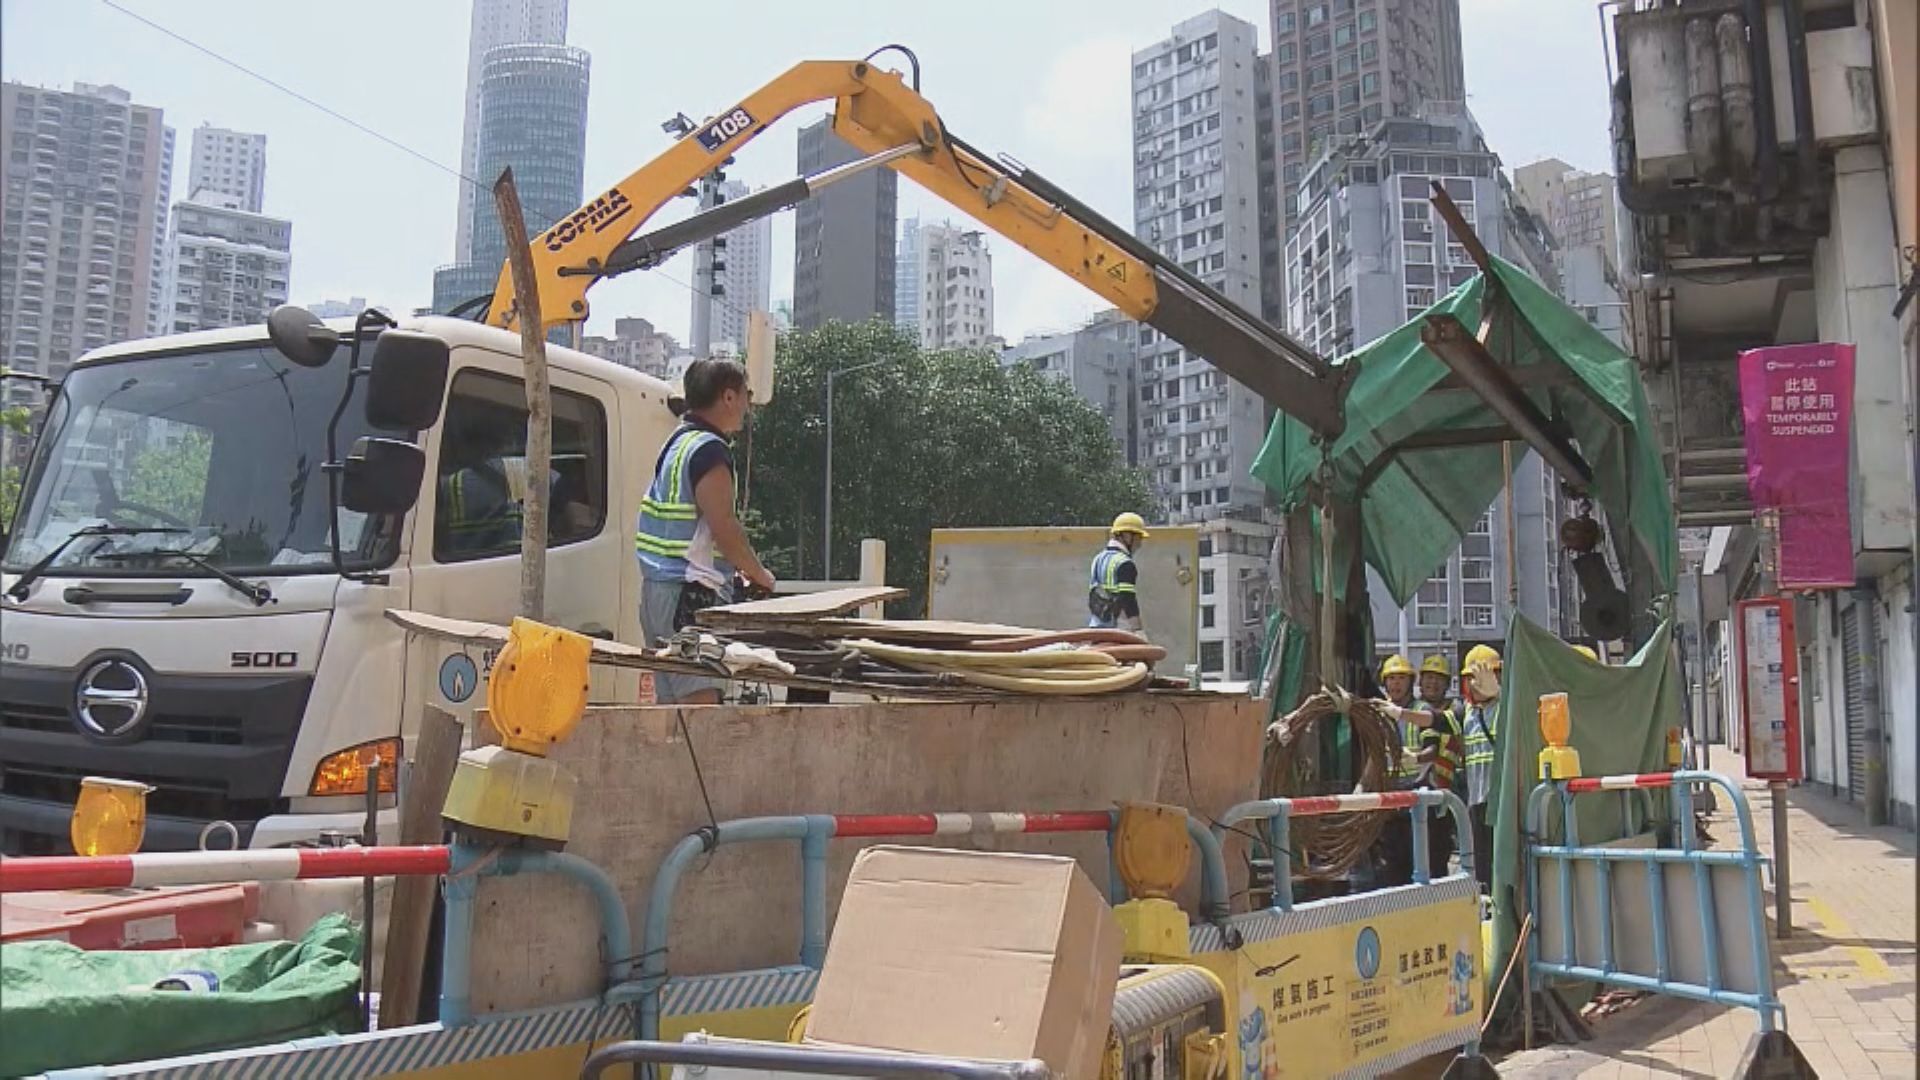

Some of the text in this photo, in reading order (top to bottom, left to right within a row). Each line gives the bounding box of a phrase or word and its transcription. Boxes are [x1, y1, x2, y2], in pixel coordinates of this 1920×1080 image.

[710, 109, 751, 142] 108
[1784, 378, 1817, 392] 此站
[1766, 412, 1838, 423] TEMPORARILY
[1771, 424, 1834, 435] SUSPENDED
[230, 651, 299, 668] 500
